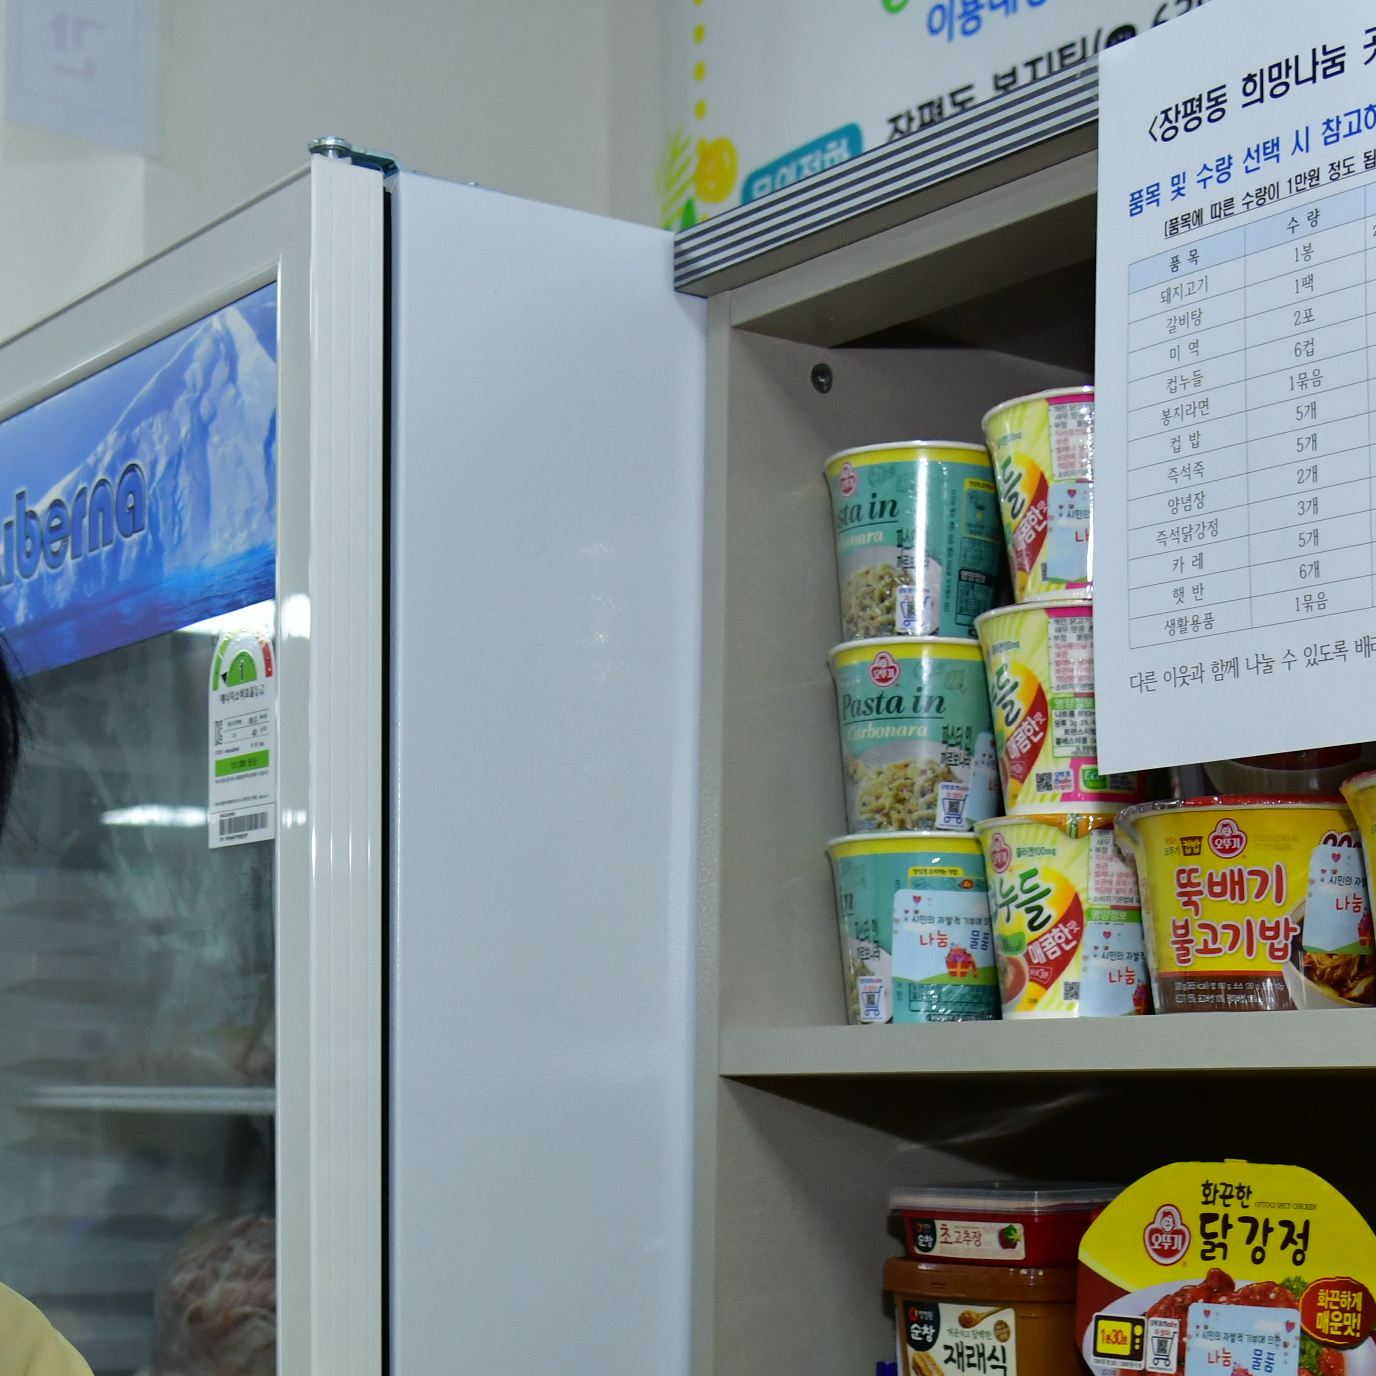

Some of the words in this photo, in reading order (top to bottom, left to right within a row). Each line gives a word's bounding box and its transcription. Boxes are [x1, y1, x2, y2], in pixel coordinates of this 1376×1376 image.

[1241, 44, 1346, 109] 희망나눔
[1129, 183, 1161, 217] 품목
[1170, 171, 1187, 201] 및
[1196, 154, 1233, 190] 수량
[1242, 136, 1280, 173] 선택
[1291, 126, 1310, 155] 시
[1210, 196, 1235, 220] 따른
[1242, 181, 1280, 211] 수량이
[1286, 167, 1320, 195] 1만원
[1328, 156, 1356, 183] 정도
[1294, 243, 1314, 264] 1봉
[1160, 275, 1209, 305] 돼지고기
[1294, 273, 1314, 296] 1팩
[1166, 307, 1203, 335] 갈비탕
[1293, 310, 1315, 328] 2포
[1294, 337, 1315, 358] 6컵
[1166, 369, 1204, 394] 컵누들
[1289, 367, 1323, 393] 1묶음
[1160, 397, 1210, 428] 봉지라면
[1295, 401, 1318, 423] 5개
[1296, 432, 1318, 453] 5개
[1167, 461, 1205, 485] 즉석죽
[1296, 463, 1319, 485] 2개
[1167, 490, 1206, 516] 양념장
[1297, 496, 1319, 517] 3개
[1155, 518, 1219, 547] 즉석닭강정
[1297, 528, 1319, 548] 5개
[1298, 560, 1320, 579] 6개
[1294, 591, 1328, 613] 1묶음
[1163, 613, 1215, 638] 생활용품
[1129, 671, 1158, 695] 다른
[1162, 661, 1206, 690] 이웃과
[1210, 656, 1240, 683] 함께
[1245, 650, 1276, 675] 나눌
[1281, 650, 1297, 672] 수
[1303, 640, 1349, 669] 있도록
[841, 691, 907, 721] Pasta
[912, 686, 946, 714] in
[847, 722, 929, 741] Carbonara
[1175, 864, 1288, 920] 뚝배기
[1328, 875, 1350, 887] 시민의
[1334, 897, 1363, 914] 나눔
[911, 915, 935, 925] 시민의
[937, 914, 961, 925] 자발적
[962, 914, 984, 926] 기부에
[918, 931, 949, 948] 나눔
[970, 929, 991, 952] 물품
[1170, 912, 1301, 971] 불고기밥
[1101, 951, 1124, 962] 시민의
[1108, 967, 1137, 985] 나눔
[1200, 1179, 1253, 1209] 화끈한
[917, 1233, 935, 1249] 순창
[1198, 1212, 1311, 1267] 닭강정
[1316, 1288, 1364, 1312] 화끈하게
[910, 1323, 936, 1343] 순창
[1315, 1311, 1362, 1338] 매운맛!
[1207, 1347, 1233, 1368] 나눔
[1251, 1348, 1276, 1374] 물품
